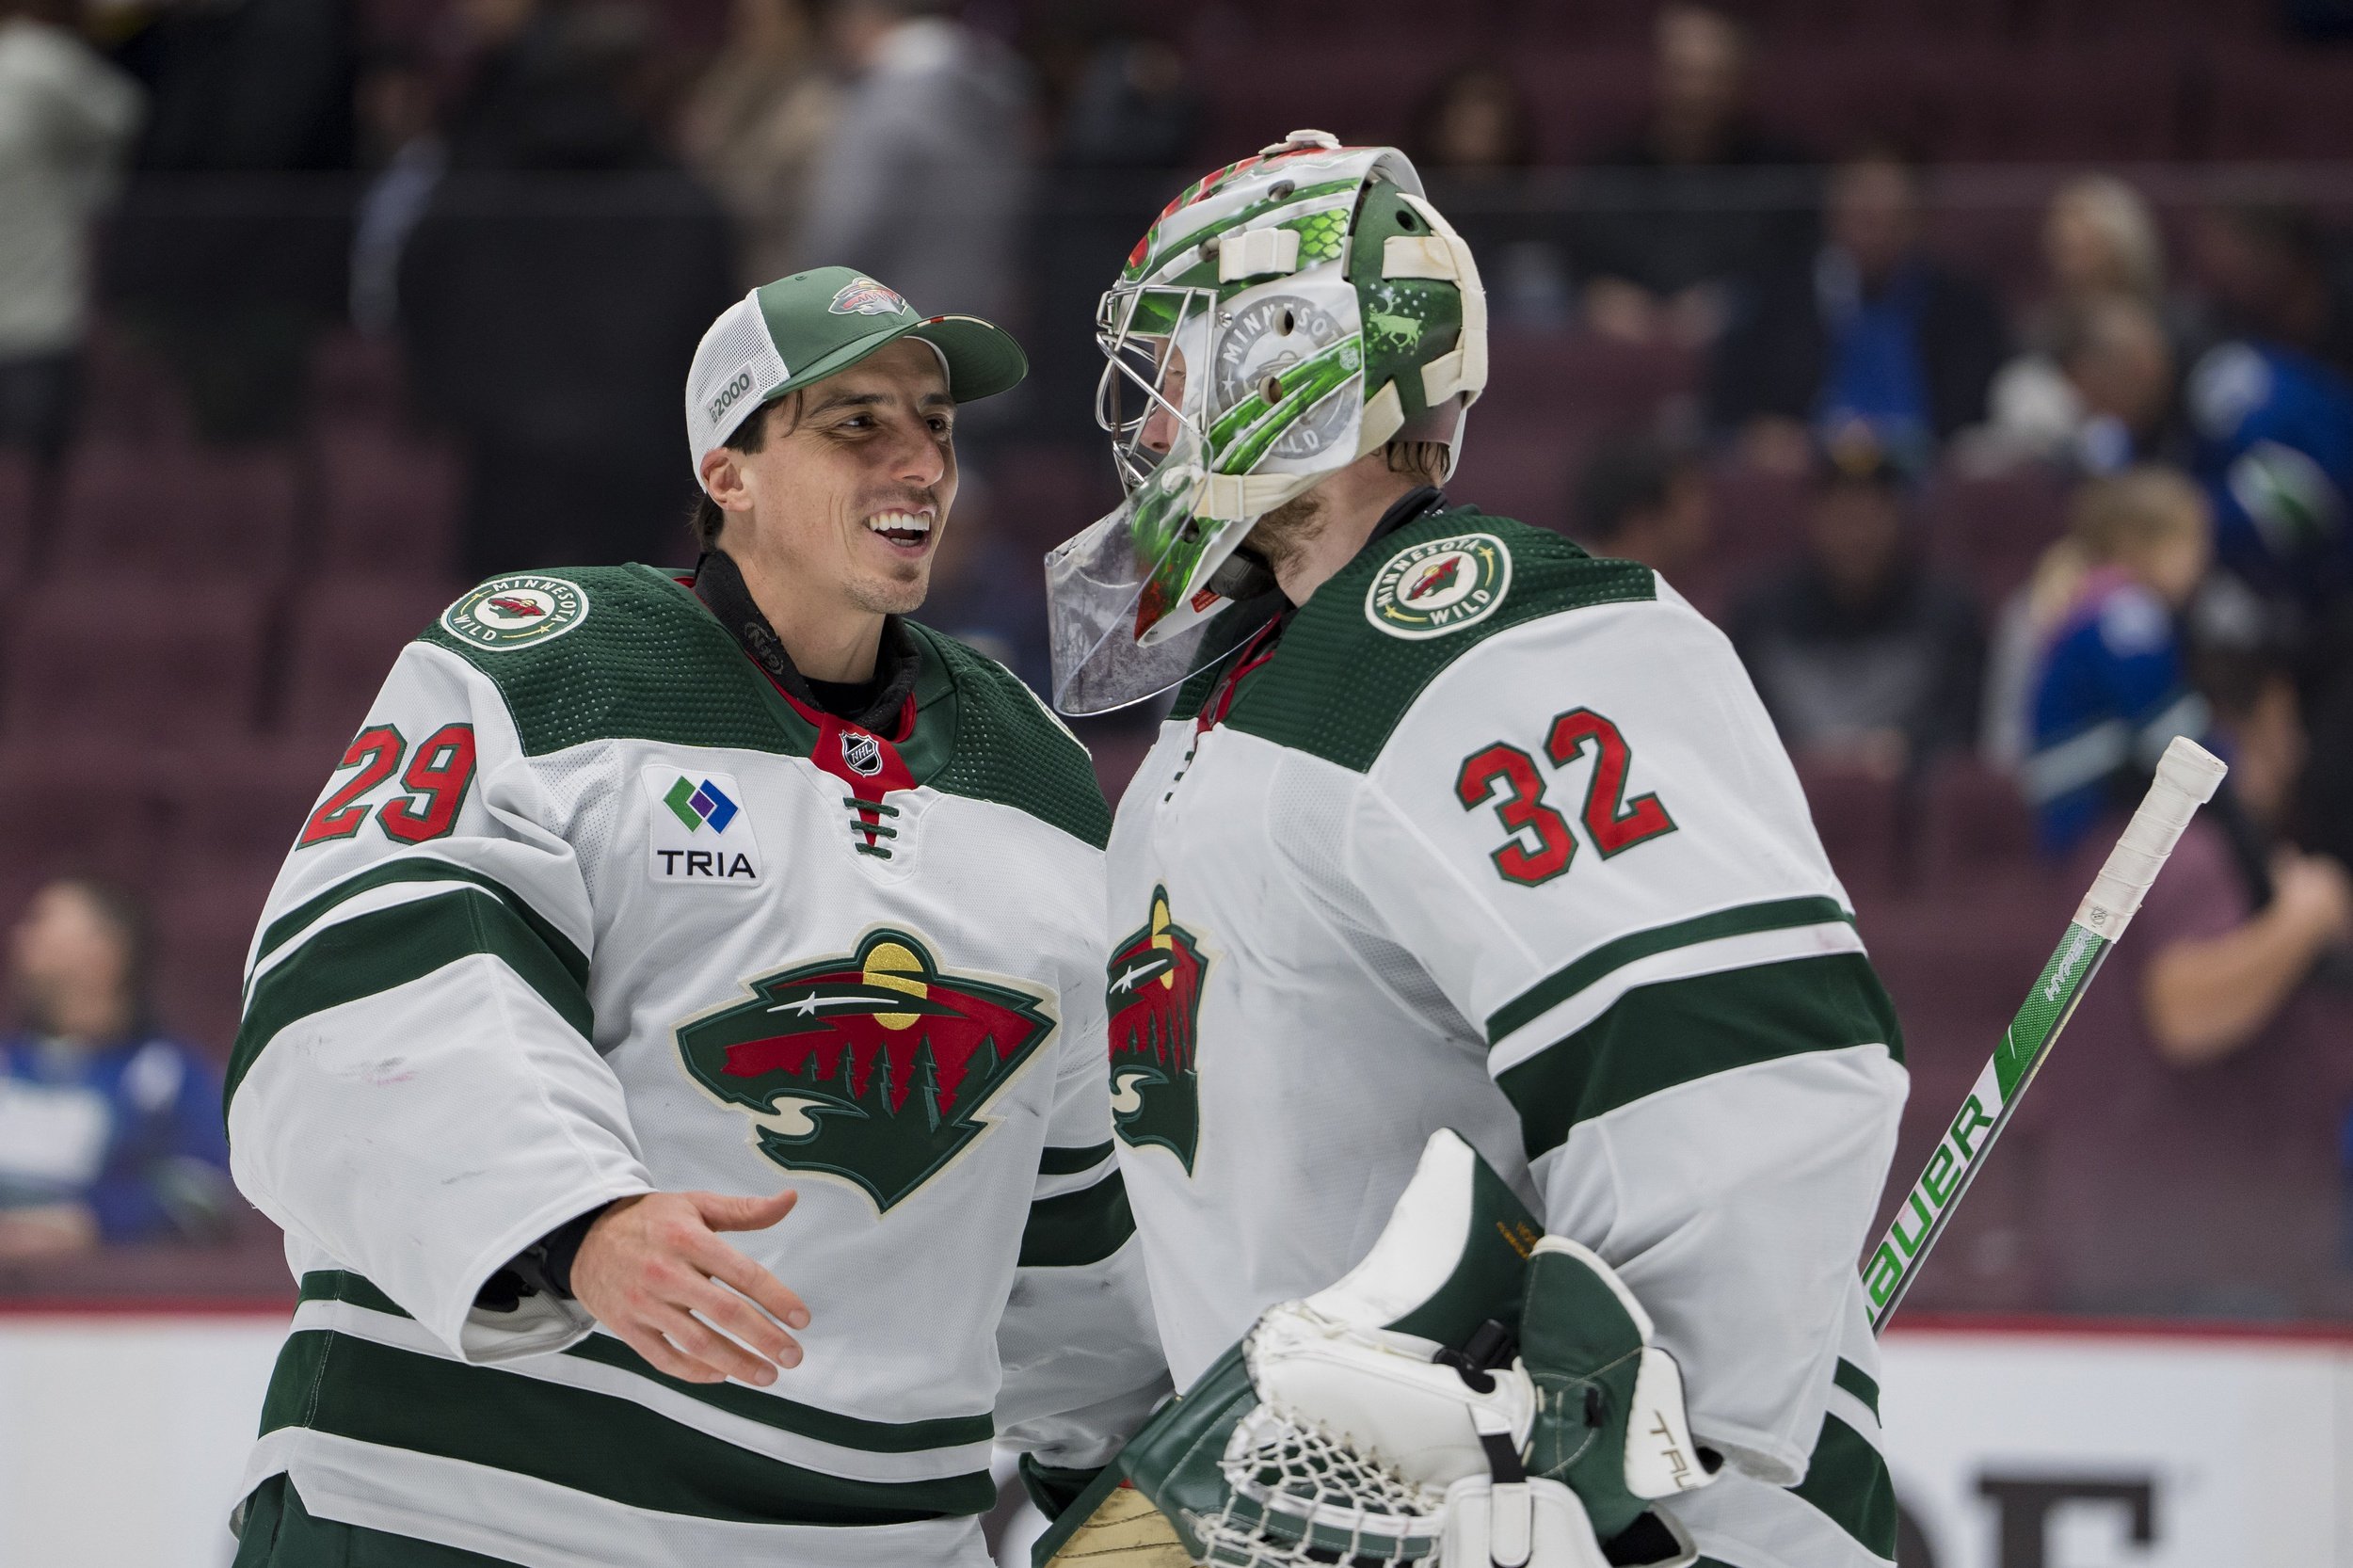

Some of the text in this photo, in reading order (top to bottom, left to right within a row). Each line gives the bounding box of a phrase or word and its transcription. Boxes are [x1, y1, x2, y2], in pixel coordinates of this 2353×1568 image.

[714, 373, 750, 416] 2000
[1376, 538, 1481, 608] MINNESOTA
[492, 579, 577, 623] MINNESOTA
[1429, 589, 1491, 626] WILD
[453, 614, 498, 642] WILD
[851, 744, 872, 763] NHL
[295, 723, 477, 852] 29
[1453, 705, 1679, 888] 32
[657, 849, 757, 879] TRIA
[1862, 1093, 1994, 1325] AUER
[1649, 1409, 1702, 1491] TRU
